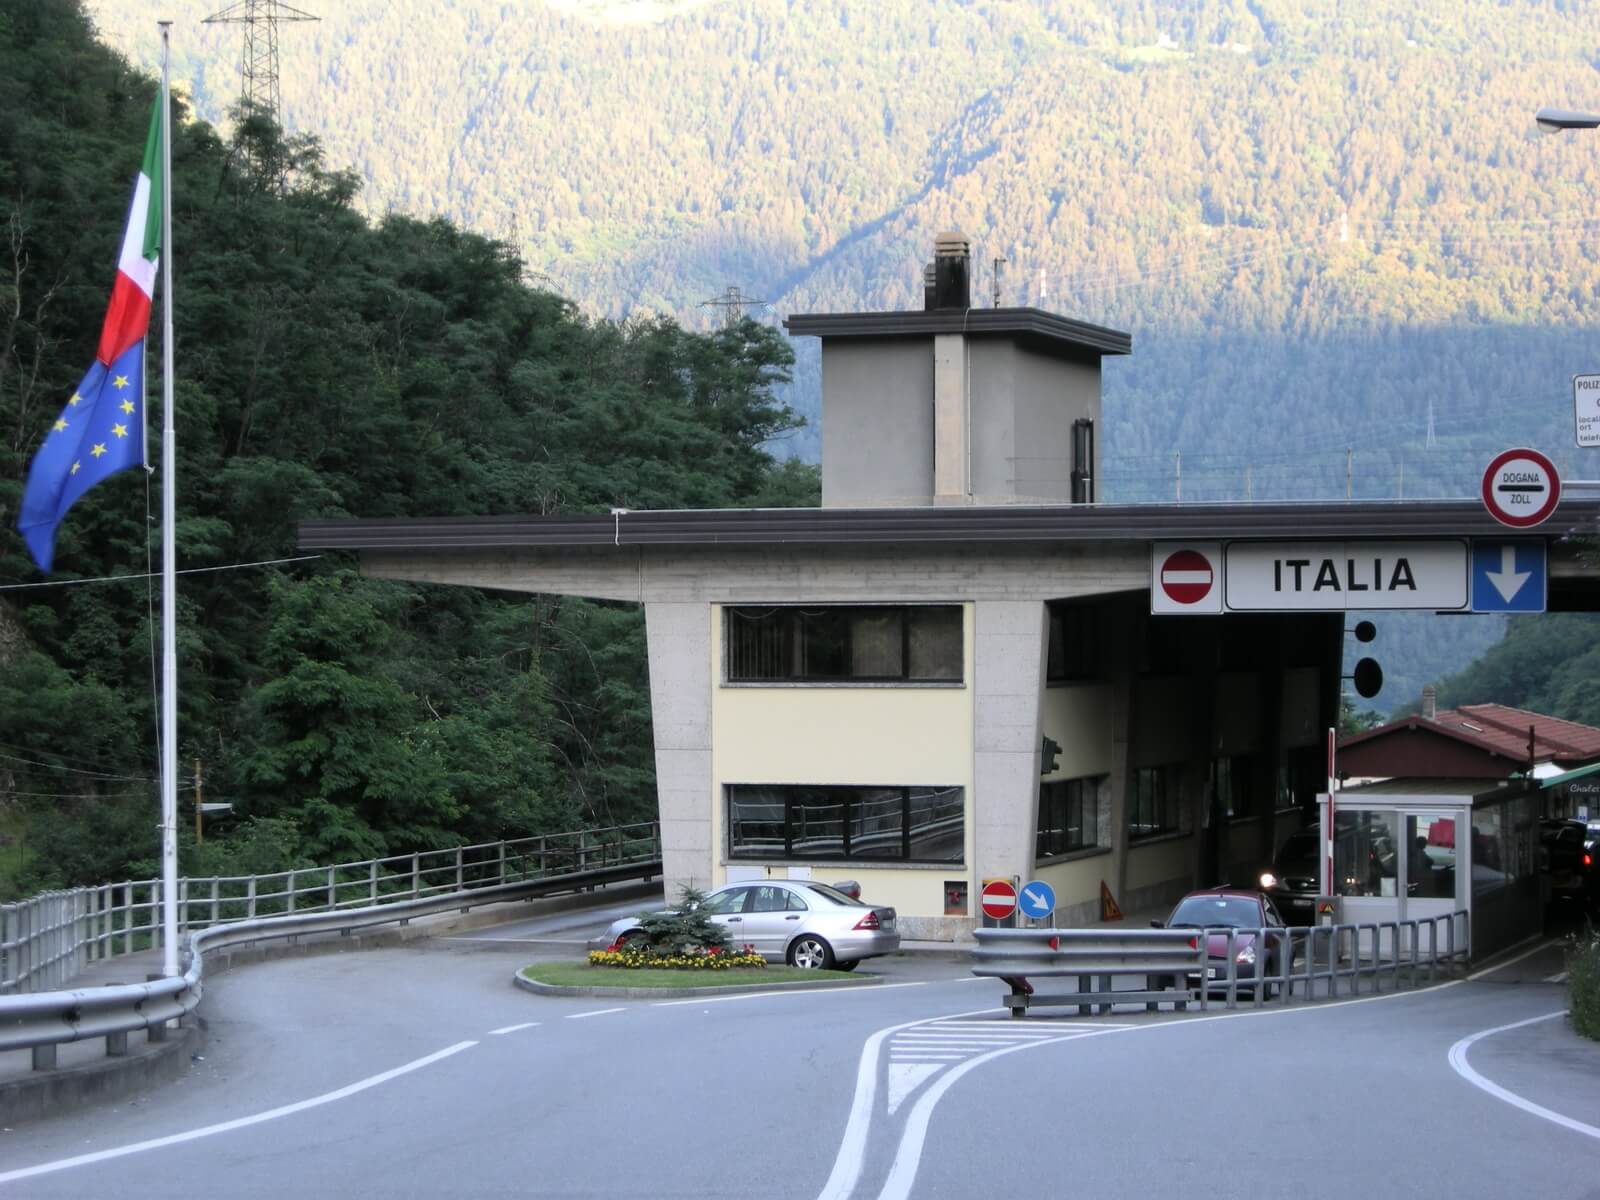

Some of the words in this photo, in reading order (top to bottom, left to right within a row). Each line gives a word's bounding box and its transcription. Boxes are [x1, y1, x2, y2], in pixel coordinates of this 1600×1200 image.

[1503, 472, 1540, 483] DOGANA
[1510, 494, 1532, 504] ZOLL
[1274, 557, 1417, 592] ITALIA
